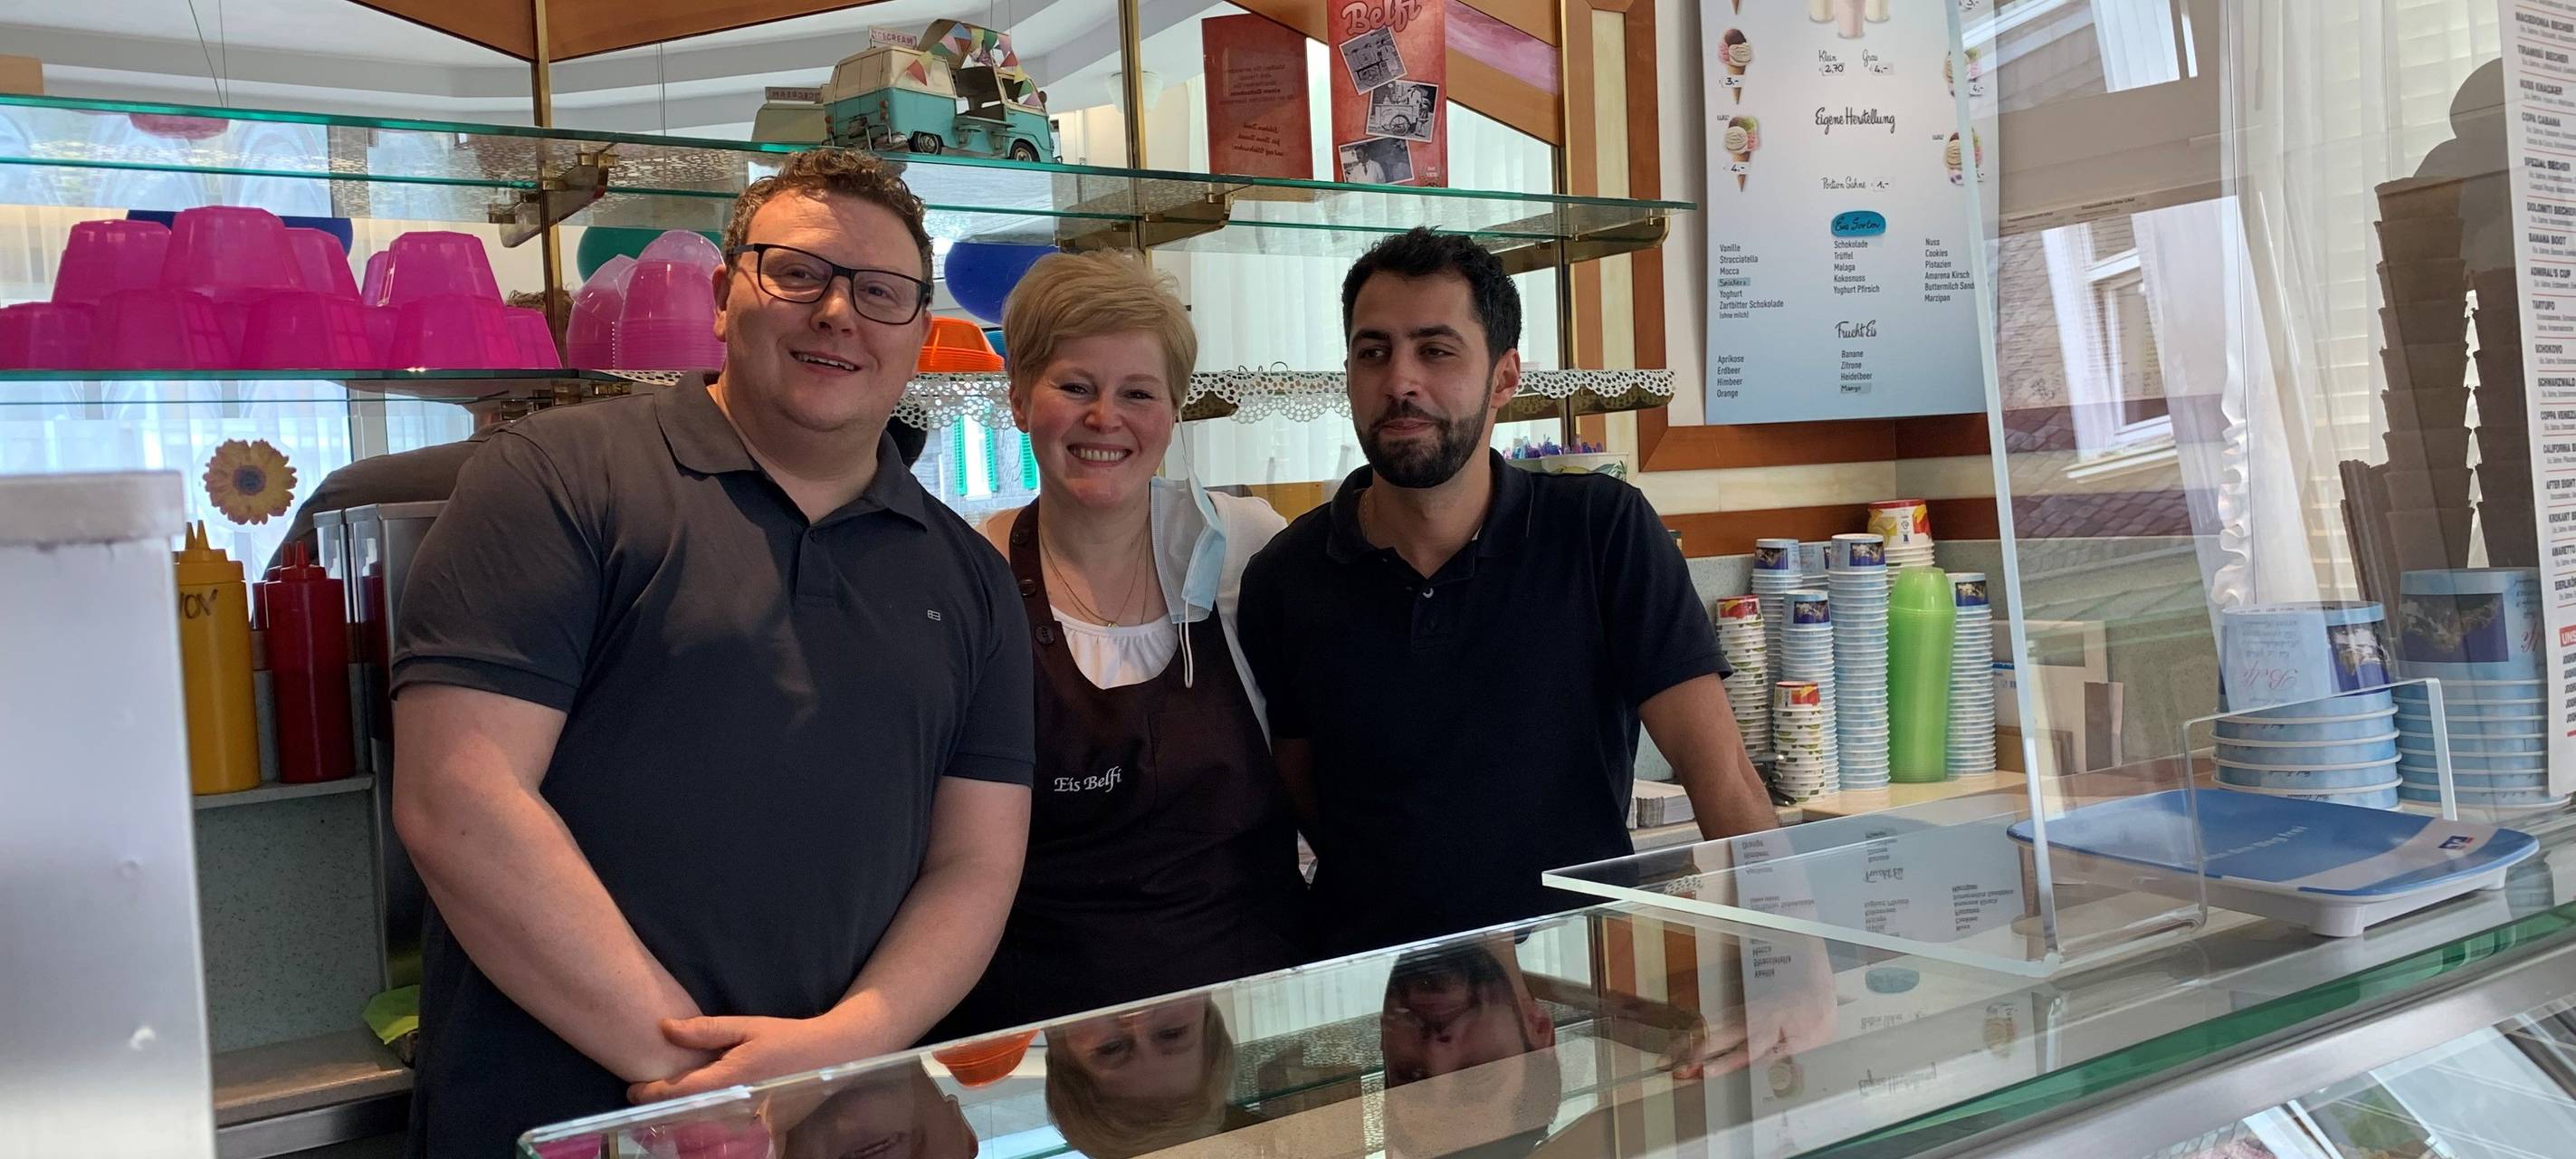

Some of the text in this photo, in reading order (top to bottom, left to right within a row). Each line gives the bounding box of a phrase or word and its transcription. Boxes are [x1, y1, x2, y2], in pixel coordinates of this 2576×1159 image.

[1341, 0, 1422, 35] Belfi
[1815, 106, 1896, 135] Eigene Herstellung
[1821, 176, 1866, 189] Portion Sahne
[1720, 244, 1741, 252] Vanille
[1834, 240, 1868, 249] Schokolade
[1834, 252, 1854, 260] Trüffel
[1925, 249, 1948, 257] Cookies
[1720, 254, 1759, 263] Stracciatella
[1834, 263, 1856, 273] Malaga
[1925, 260, 1951, 268] Pistazien
[1720, 267, 1740, 275] Mocca
[1925, 270, 1970, 280] Amarena Kirsch
[1833, 284, 1880, 295] Yoghurt Pfirsich
[1924, 283, 1959, 291] Buttermilch
[1720, 290, 1742, 300] Yoghurt
[1924, 294, 1951, 303] Marzipan
[1720, 300, 1784, 310] Zartbitter Schokolade
[1835, 319, 1877, 339] Frucht Eis
[1841, 350, 1864, 358] Banane
[1717, 355, 1744, 365] Aprikose
[1841, 361, 1862, 369] Zitrone
[1717, 367, 1741, 375] Erdbeer
[1840, 372, 1873, 380] Heidelbeer
[1717, 378, 1742, 387] Himbeer
[1716, 389, 1739, 398] Orange
[1054, 766, 1122, 792] Eis Belfi
